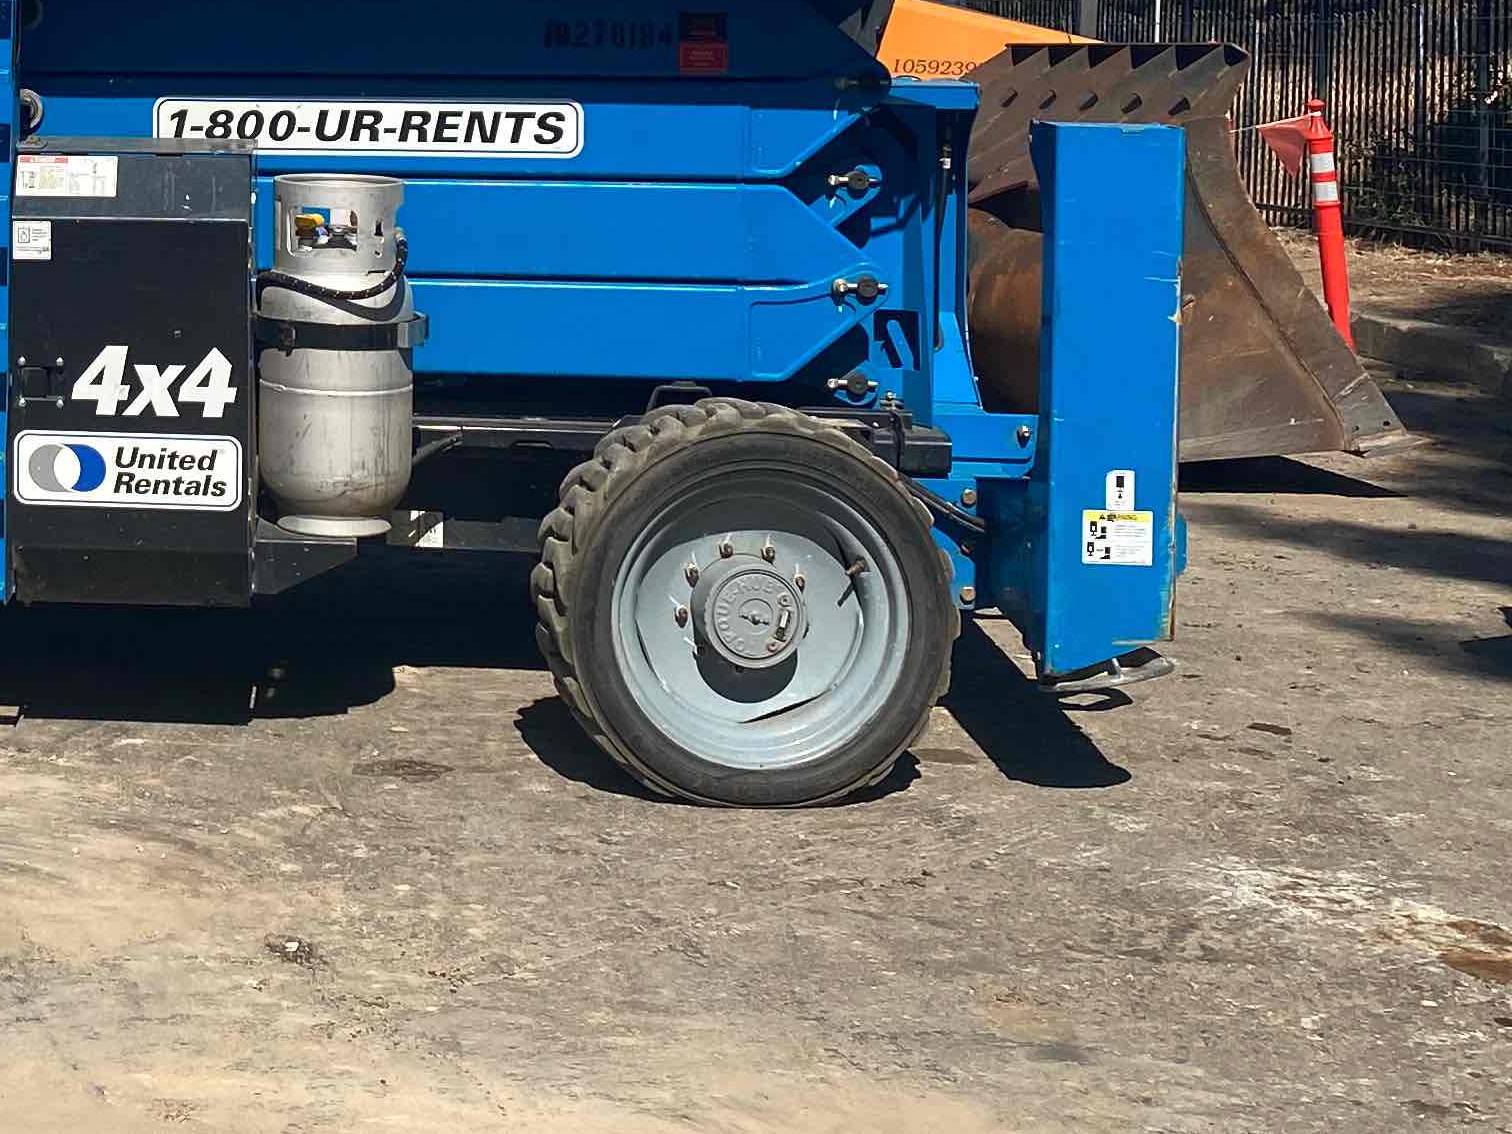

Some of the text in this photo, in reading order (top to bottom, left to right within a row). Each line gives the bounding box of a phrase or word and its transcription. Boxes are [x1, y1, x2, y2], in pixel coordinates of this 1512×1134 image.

[168, 108, 567, 145] 1-800-UR-RENTS
[71, 345, 238, 418] 4x4
[114, 446, 218, 471] United
[112, 471, 228, 498] Rentals
